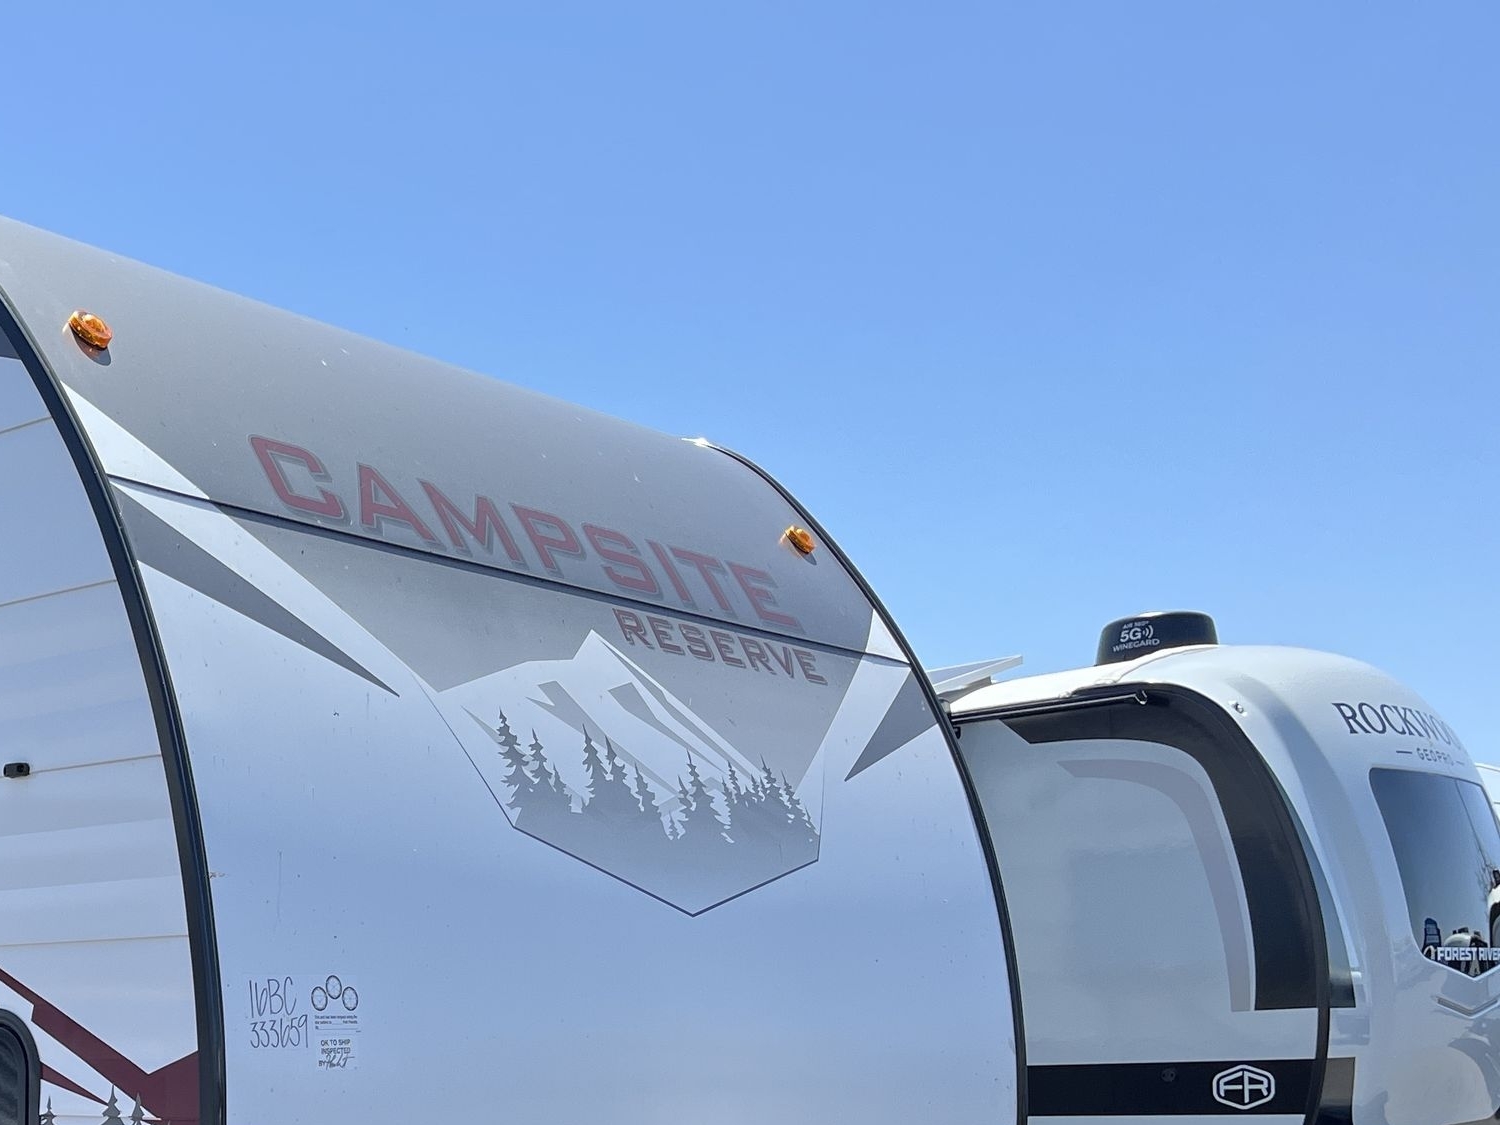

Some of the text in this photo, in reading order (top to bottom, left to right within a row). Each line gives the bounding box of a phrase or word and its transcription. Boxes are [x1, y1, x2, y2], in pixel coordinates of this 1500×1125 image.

[248, 434, 803, 631] CAMPSITE
[612, 608, 828, 686] RESERVE
[1112, 638, 1160, 652] WINEGARD
[1120, 628, 1142, 642] 5G
[1437, 947, 1477, 961] FOREST
[249, 976, 297, 1018] 16BC
[250, 1014, 308, 1048] 333659
